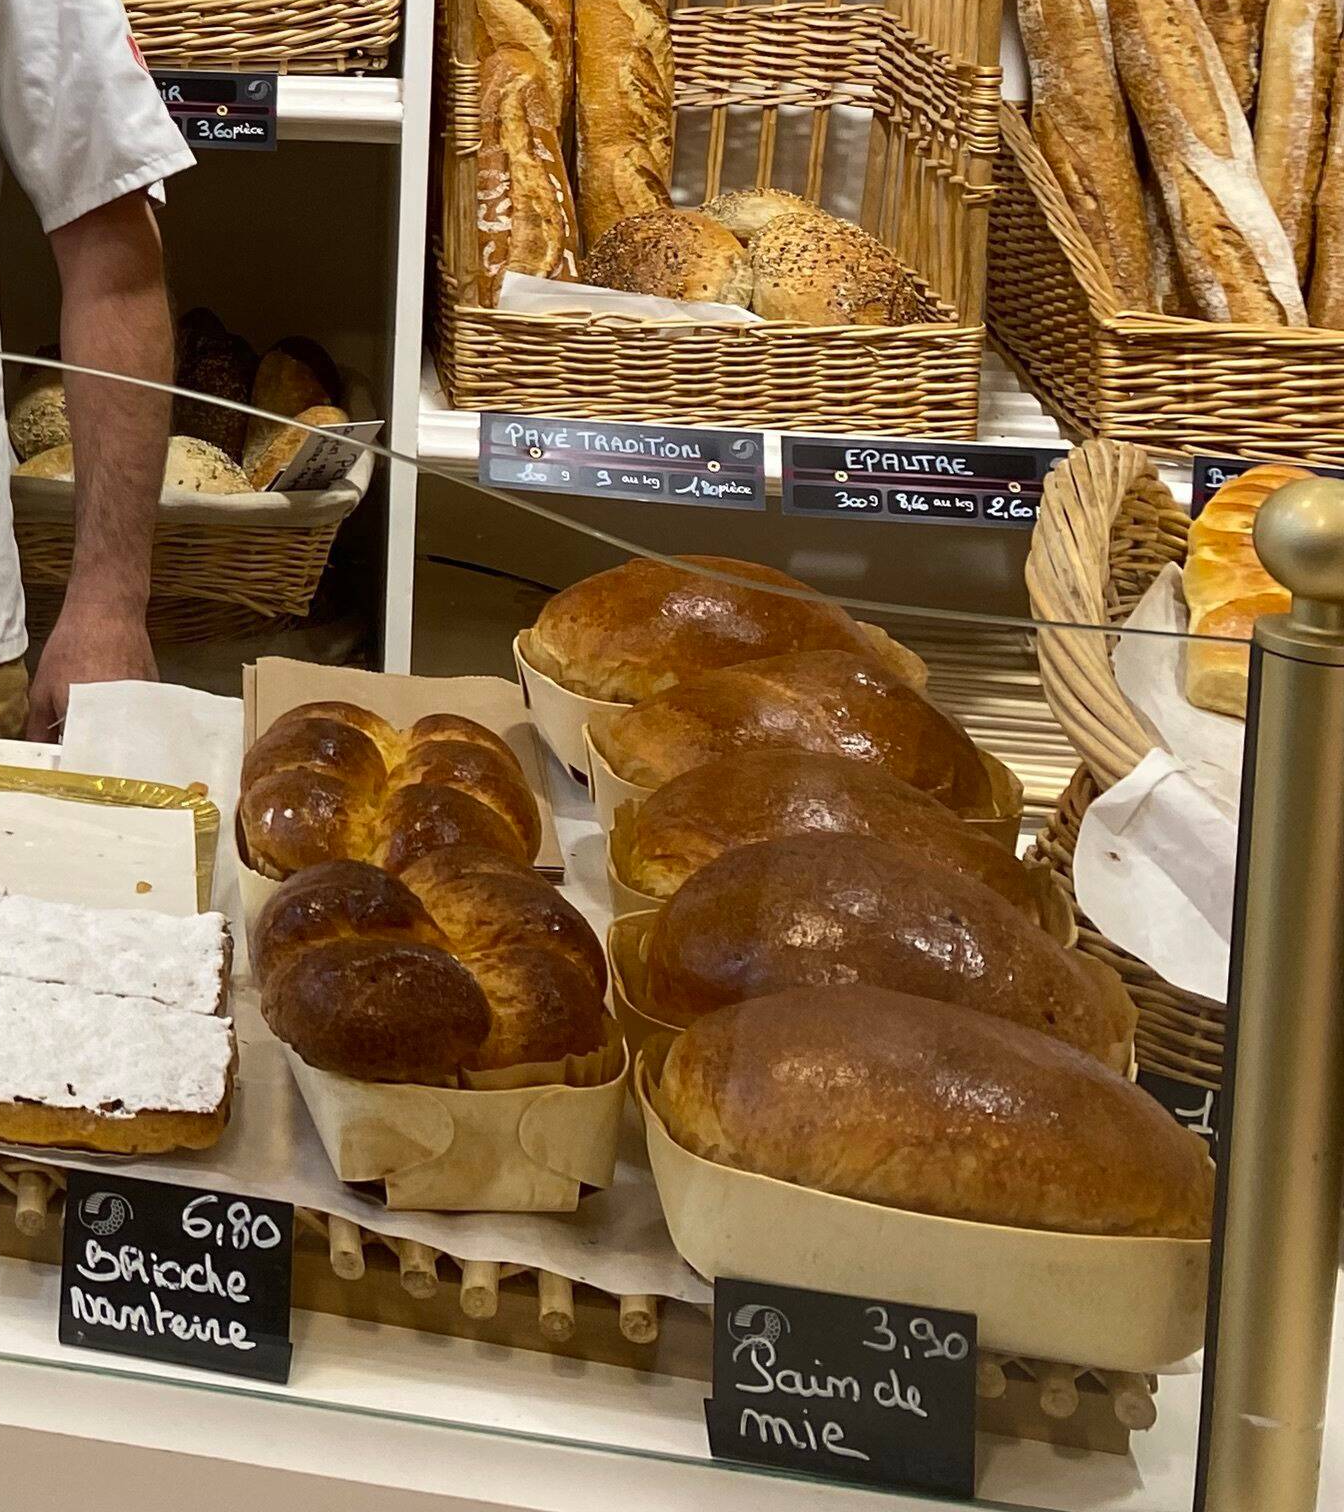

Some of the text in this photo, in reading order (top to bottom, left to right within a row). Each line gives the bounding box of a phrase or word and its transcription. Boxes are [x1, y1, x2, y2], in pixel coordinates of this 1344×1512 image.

[196, 119, 234, 140] 3,60
[576, 431, 701, 459] TRADITION
[845, 448, 975, 477] EPAUTRE
[562, 470, 571, 482] g
[596, 470, 612, 487] 9
[621, 474, 640, 485] au
[643, 475, 660, 489] kg
[933, 497, 952, 508] au
[955, 498, 974, 512] kg
[987, 497, 1033, 519] 2,60
[182, 1194, 281, 1250] 6,80
[863, 1306, 969, 1361] 3,90
[874, 1368, 928, 1418] de
